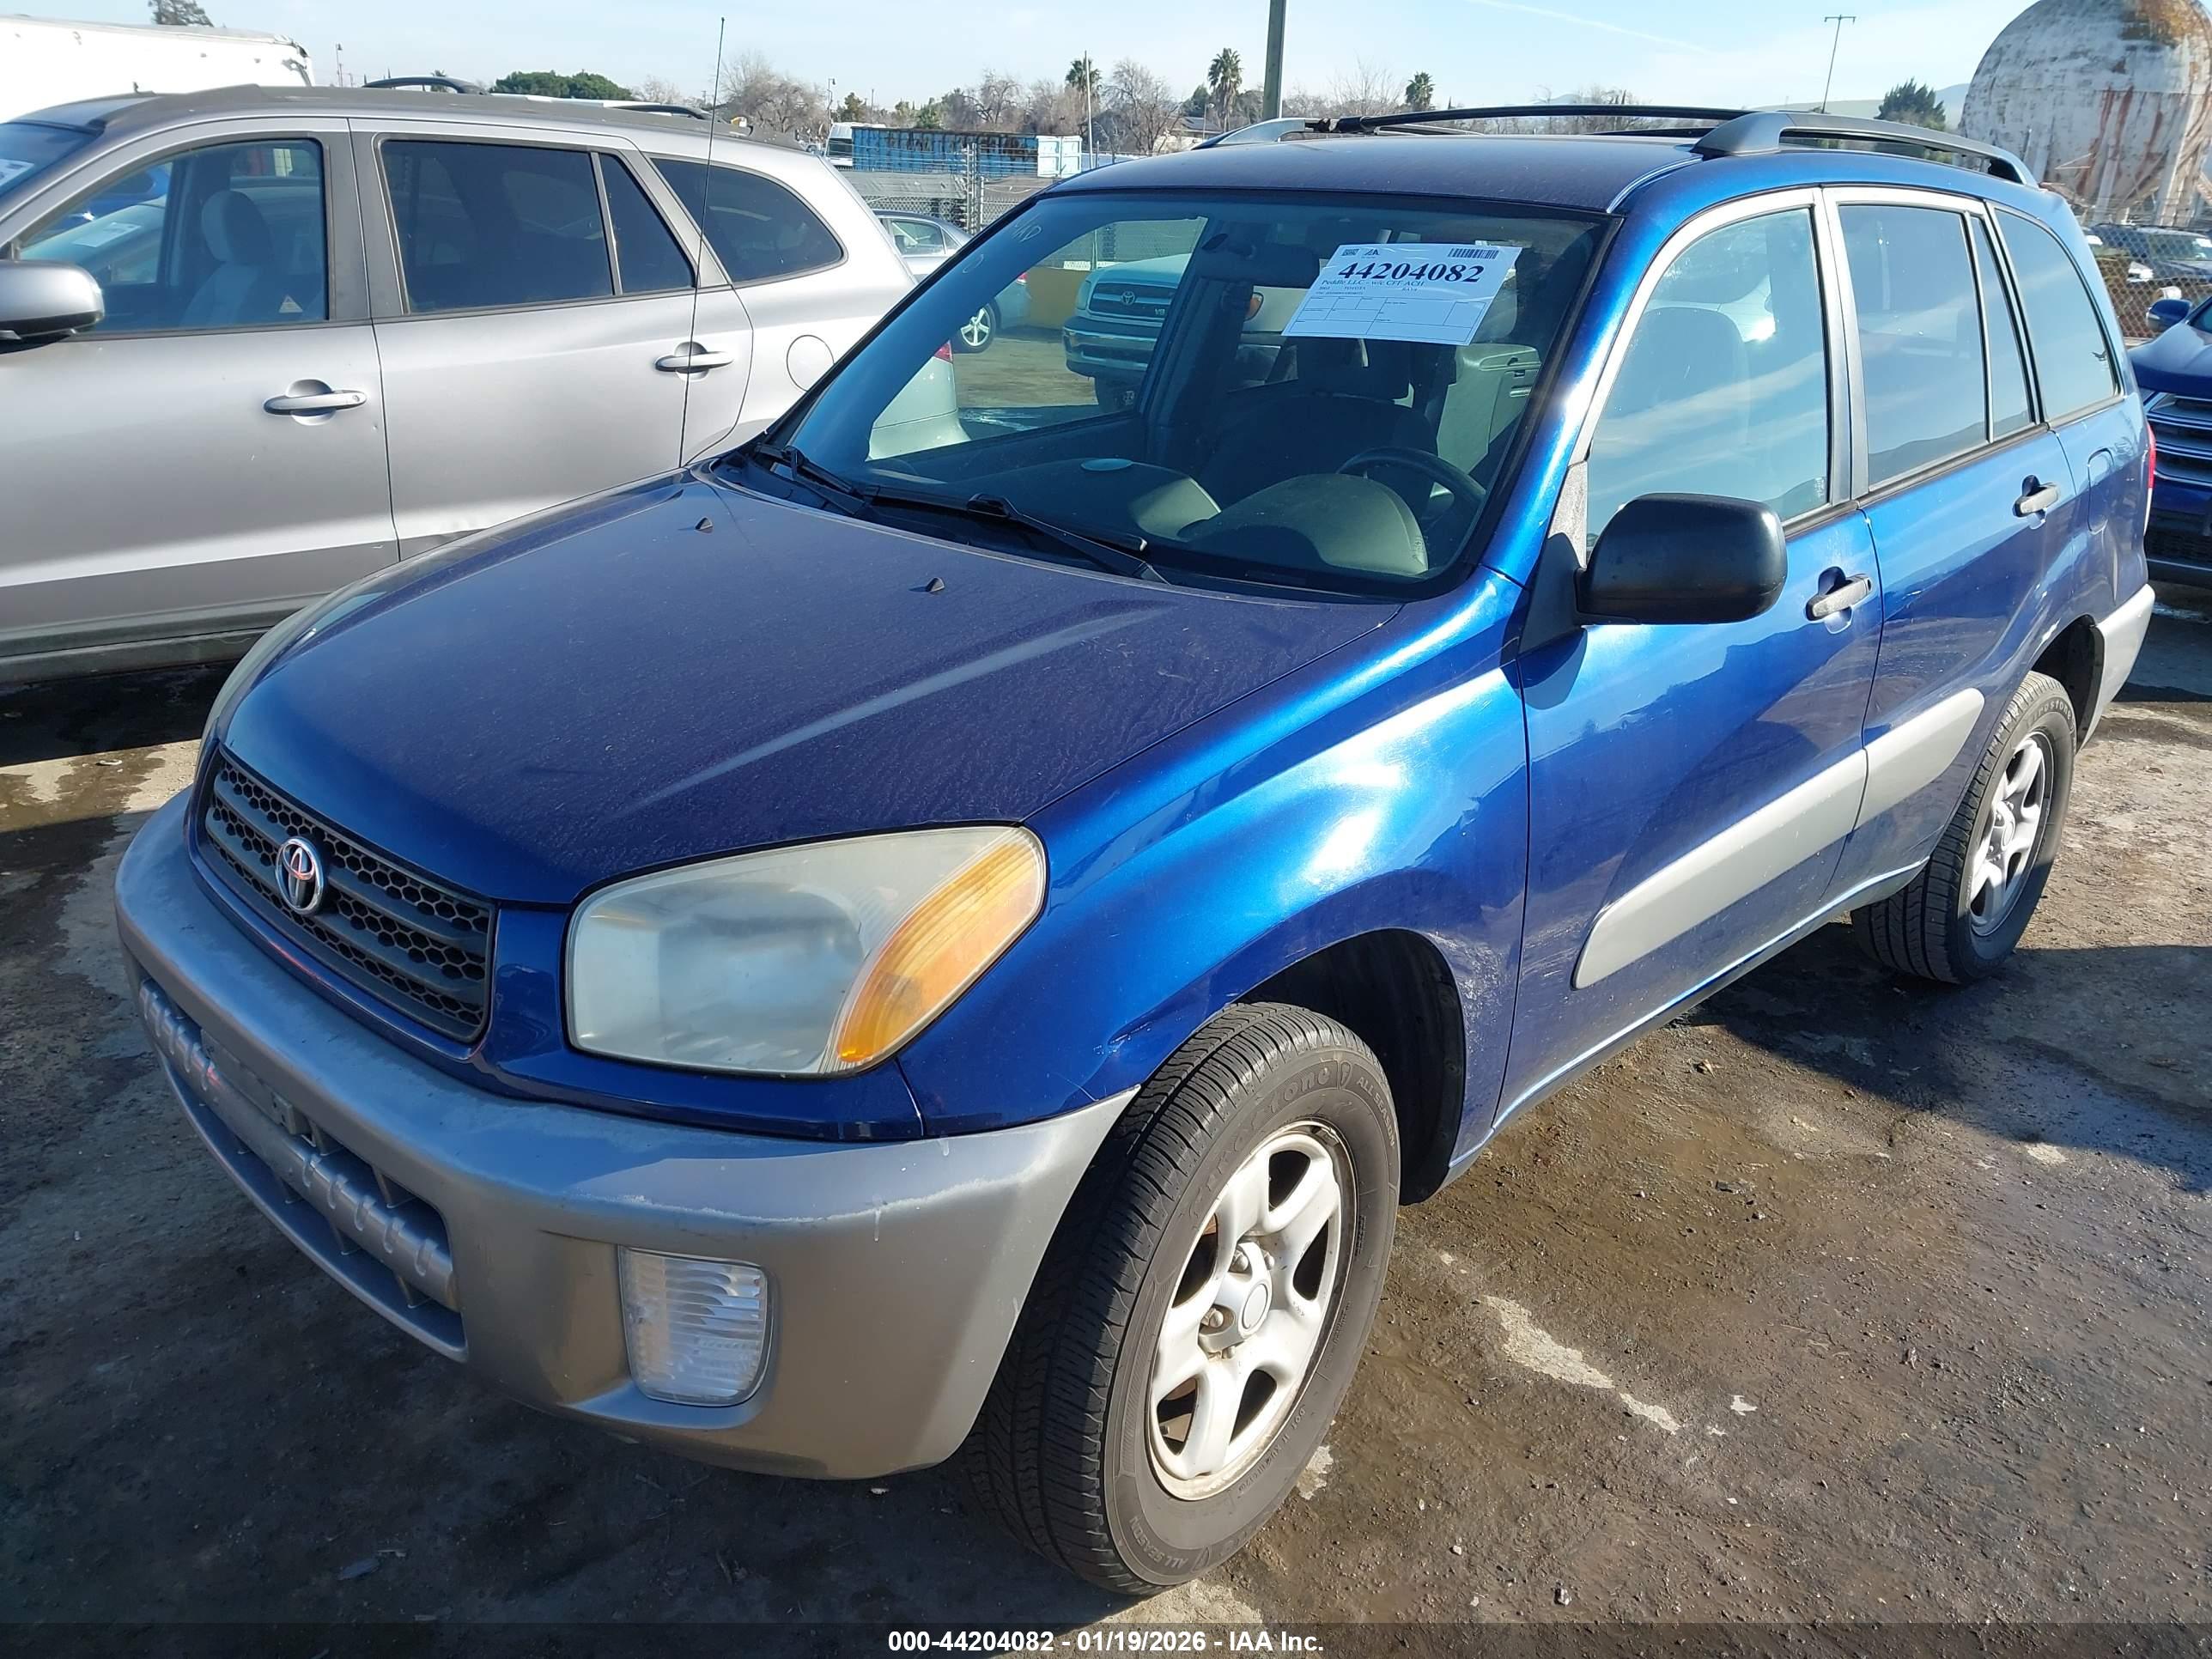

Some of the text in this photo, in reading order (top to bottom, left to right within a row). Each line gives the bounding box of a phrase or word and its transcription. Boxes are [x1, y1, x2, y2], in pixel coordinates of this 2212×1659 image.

[1339, 262, 1485, 283] 44204082
[1356, 1076, 1396, 1147] ALL SEASON
[1128, 1516, 1188, 1569] ALL SEASON
